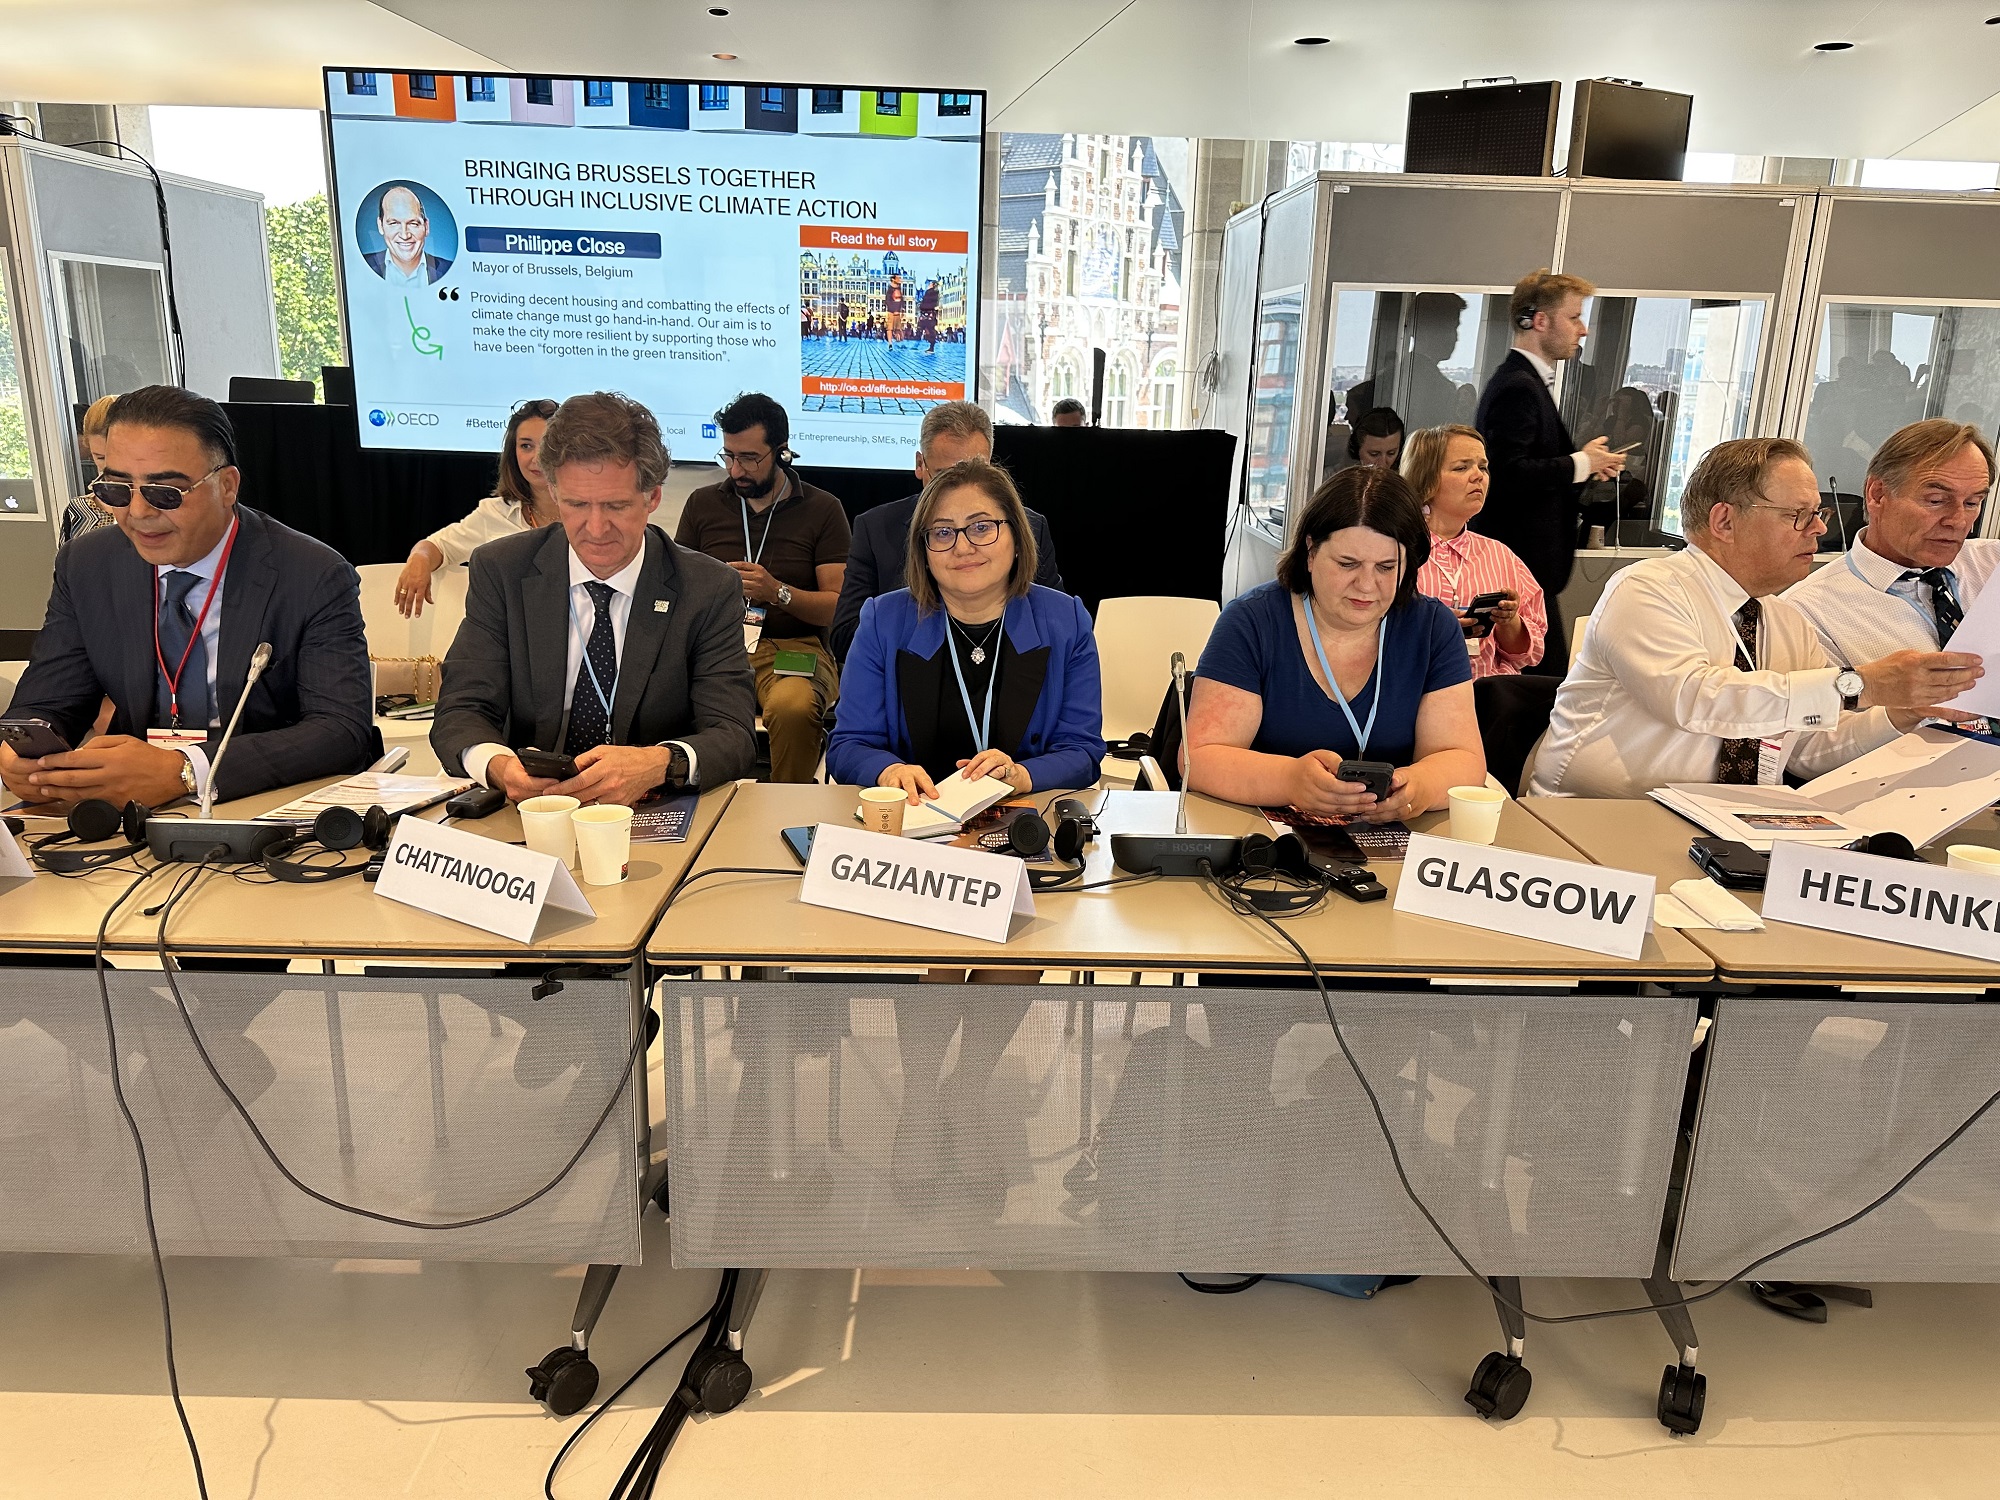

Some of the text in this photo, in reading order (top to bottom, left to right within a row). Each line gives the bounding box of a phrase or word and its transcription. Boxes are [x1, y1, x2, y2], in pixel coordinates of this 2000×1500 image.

[465, 159, 816, 190] BRINGING BRUSSELS TOGETHER
[465, 186, 877, 220] THROUGH INCLUSIVE CLIMATE ACTION
[505, 234, 626, 255] Philippe Close
[830, 231, 937, 250] Read the full story
[472, 261, 633, 280] Mayor of Brussels, Belgium
[470, 291, 790, 315] Providing decent housing and combatting the effects of
[471, 308, 772, 331] climate change must go hand-in-hand. Our aim is to
[473, 325, 776, 348] make the city more resilient by supporting those who
[474, 341, 502, 353] have
[506, 342, 535, 354] been
[597, 345, 607, 356] in
[610, 346, 629, 358] the
[632, 349, 666, 360] green
[819, 381, 947, 396] http://oe.cd/affordable-cities
[397, 412, 440, 426] OECD
[799, 432, 870, 445] Entrepreneurship,
[871, 435, 898, 445] SMEs,
[1172, 843, 1212, 853] BOSCH
[394, 842, 537, 905] CHATTANOOGA
[830, 852, 1002, 908] GAZIANTEP
[1416, 856, 1638, 926] GLASGOW
